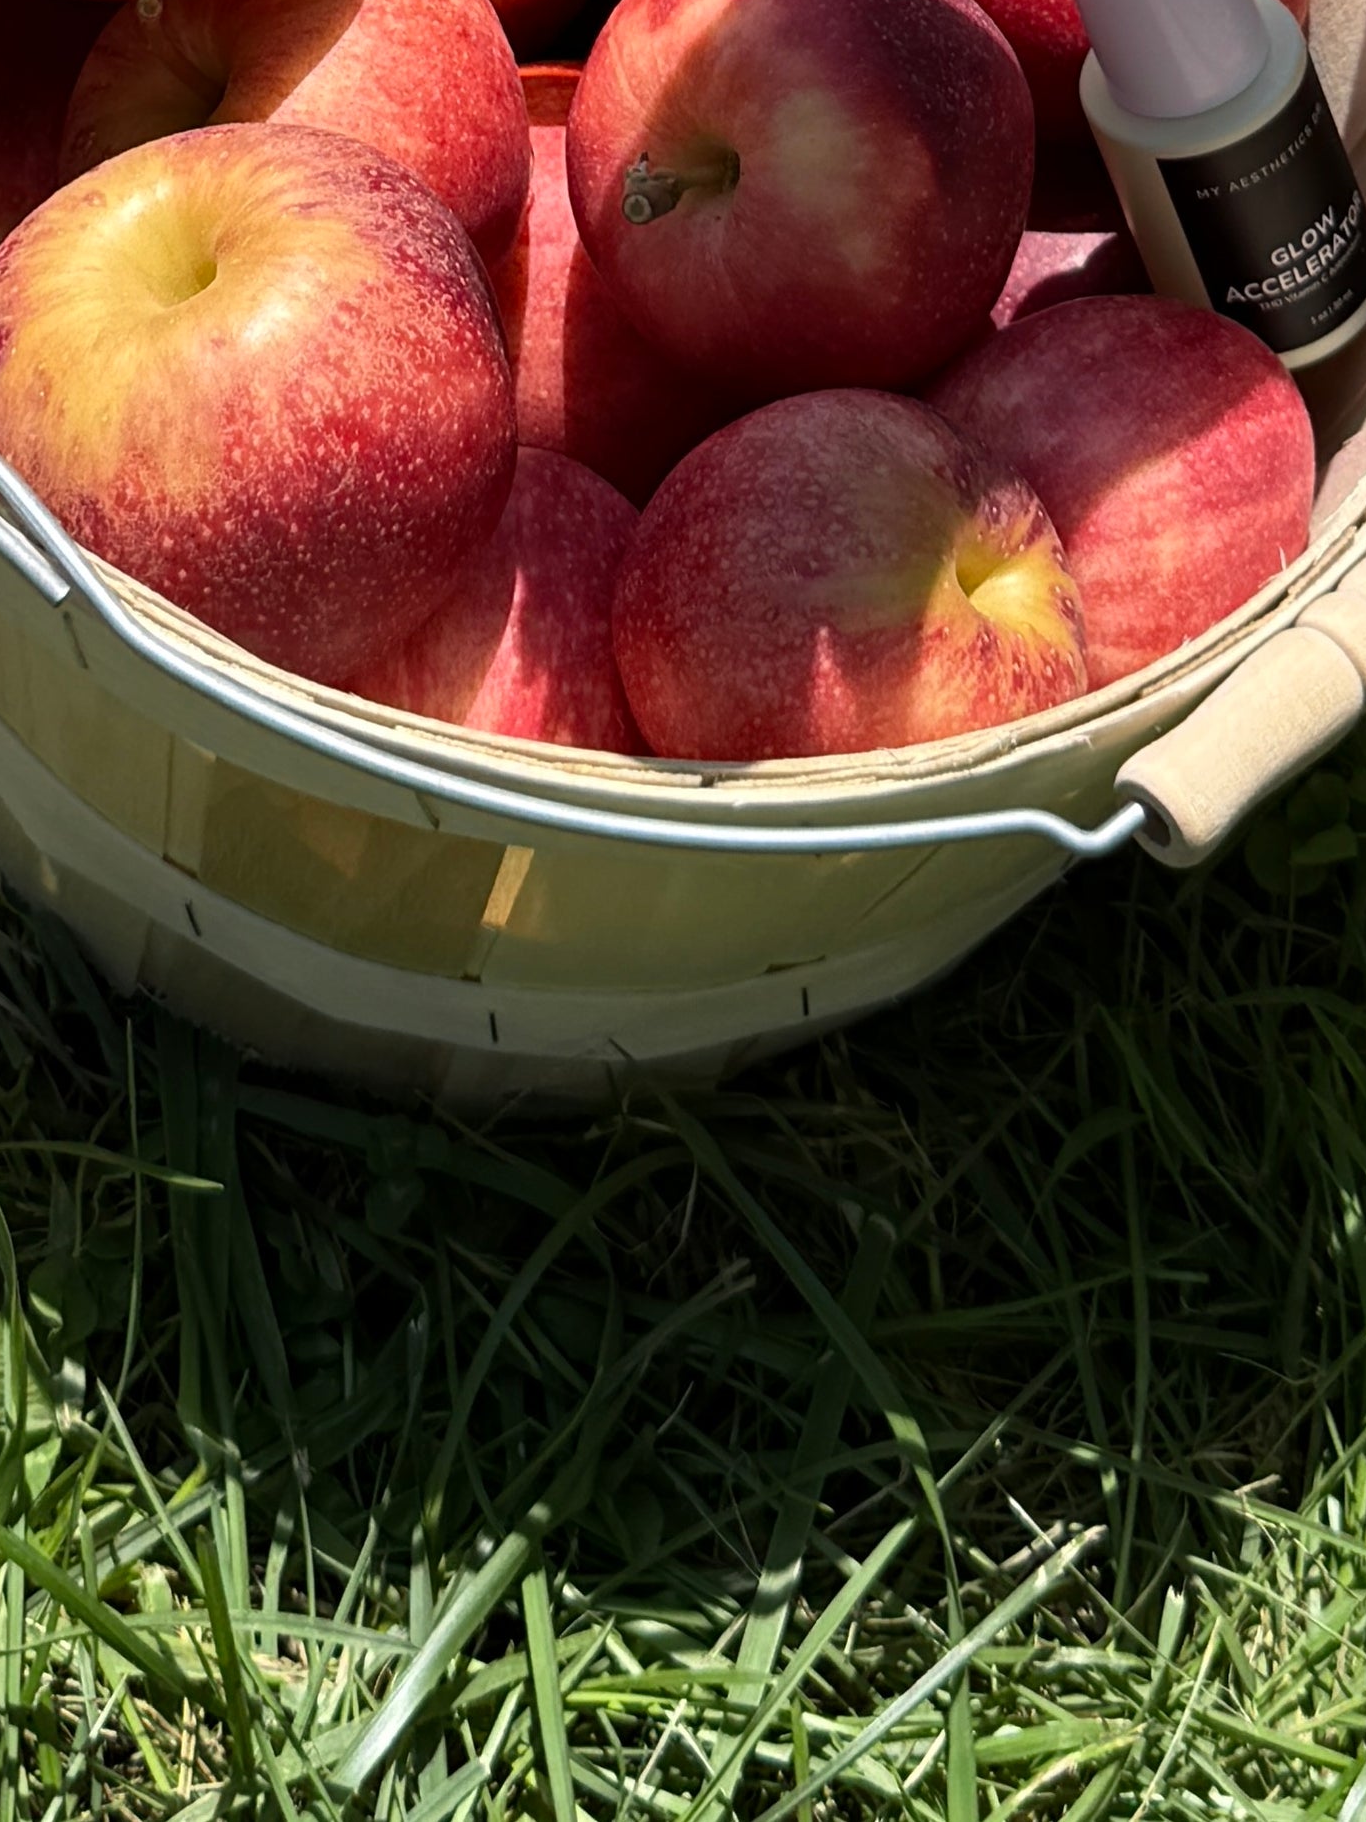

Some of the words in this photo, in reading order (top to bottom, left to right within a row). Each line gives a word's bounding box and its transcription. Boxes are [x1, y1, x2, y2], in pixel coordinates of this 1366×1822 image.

[1195, 185, 1220, 200] MY
[1228, 123, 1313, 194] AESTHETICS
[1225, 190, 1363, 304] ACCELERATOR
[1270, 204, 1336, 268] GLOW
